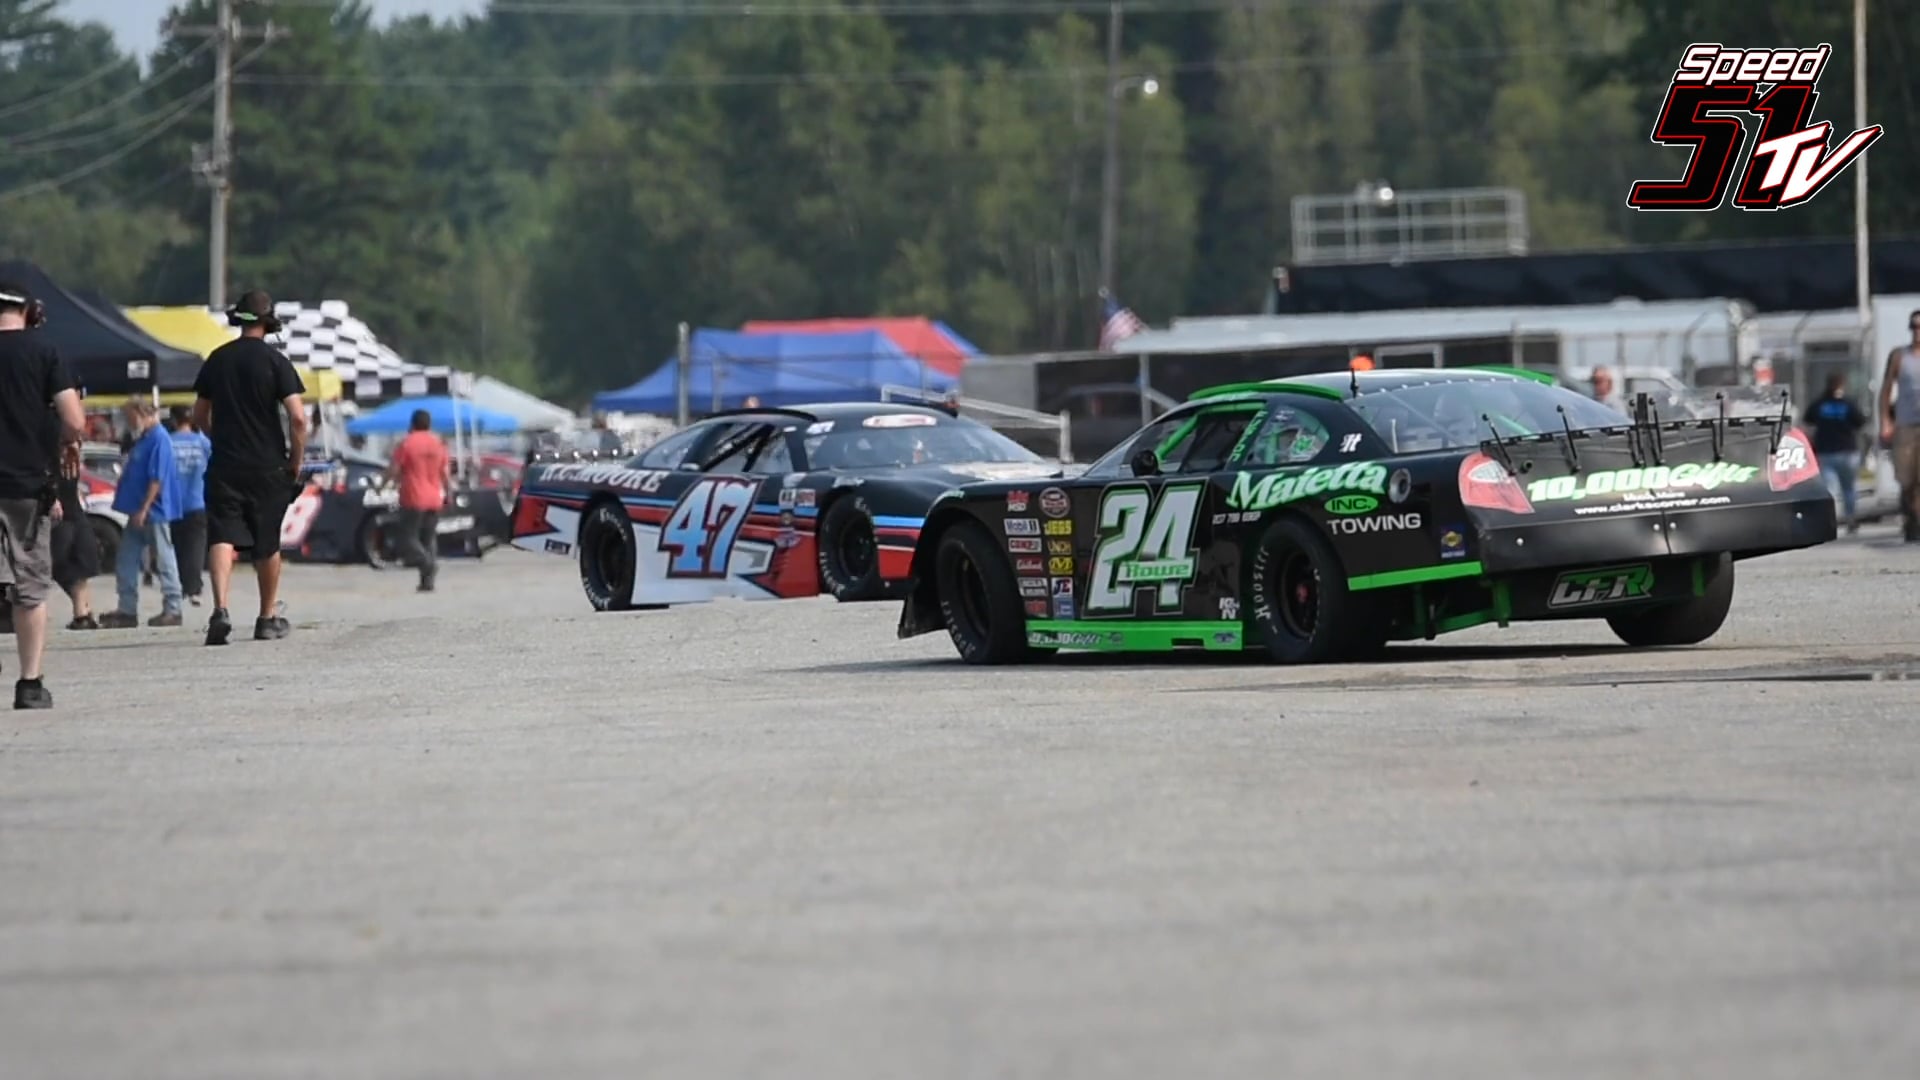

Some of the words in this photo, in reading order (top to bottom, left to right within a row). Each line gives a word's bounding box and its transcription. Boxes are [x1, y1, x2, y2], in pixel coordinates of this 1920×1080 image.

[1775, 447, 1806, 472] 24
[1226, 461, 1388, 510] Maietta
[1331, 497, 1372, 511] INC.
[660, 477, 762, 577] 47
[1327, 512, 1422, 535] TOWING
[1085, 480, 1203, 612] 24
[1125, 562, 1190, 580] Rowe
